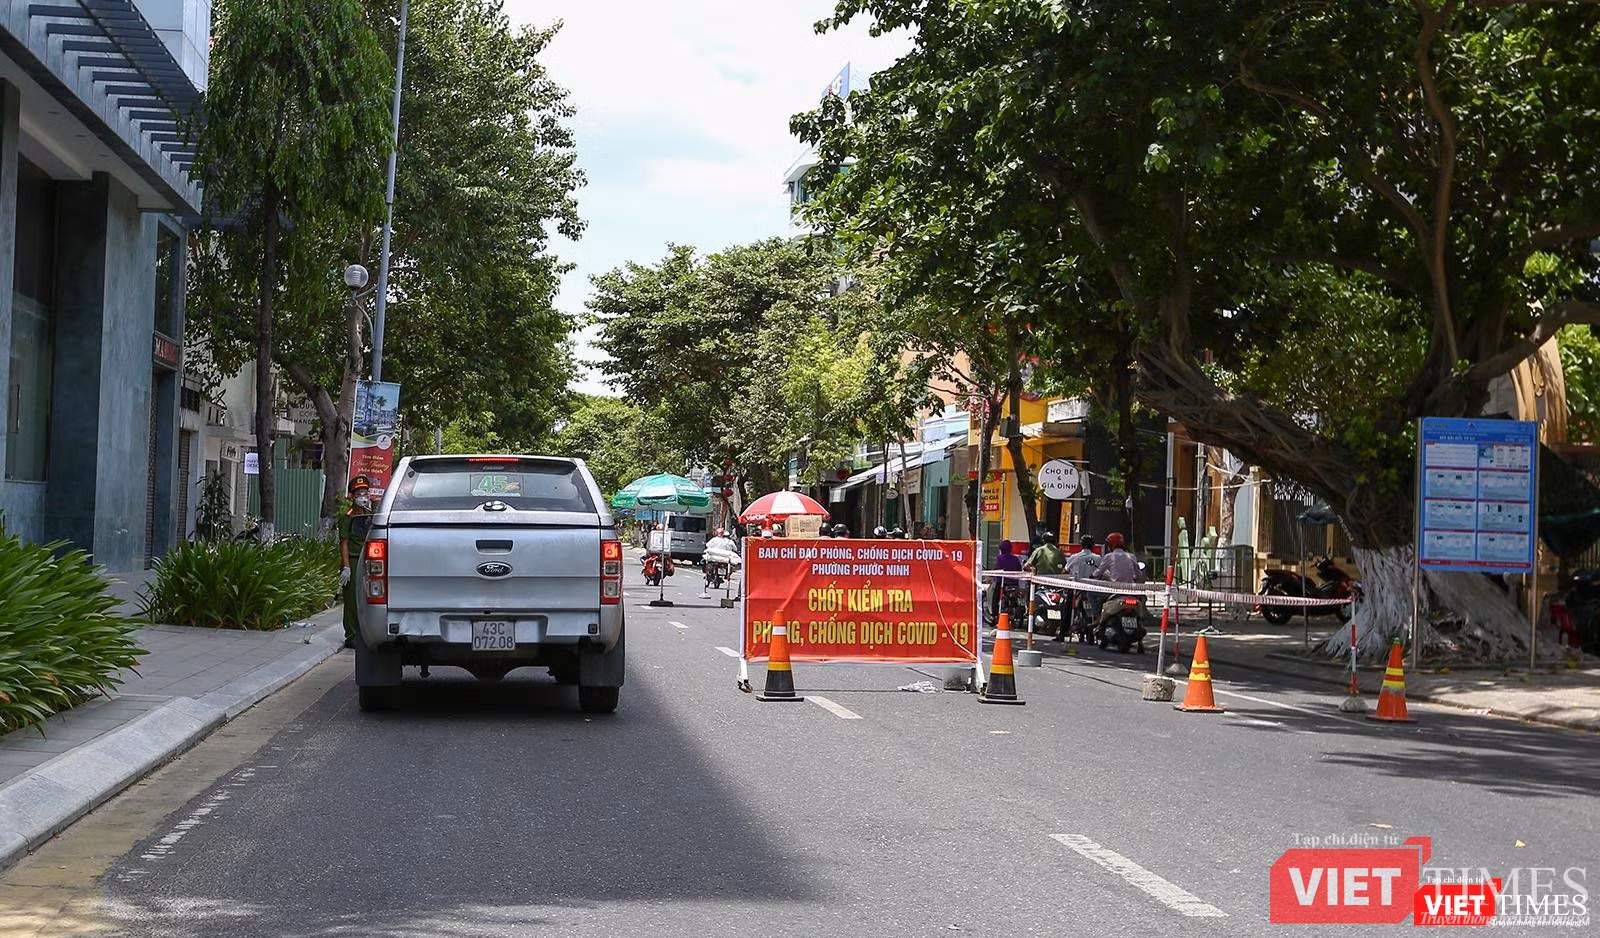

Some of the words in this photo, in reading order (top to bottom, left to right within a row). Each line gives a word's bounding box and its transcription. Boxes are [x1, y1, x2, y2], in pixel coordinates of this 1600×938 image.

[758, 547, 779, 559] BAN
[780, 544, 797, 559] CHỈ
[799, 547, 818, 561] ĐẠO
[820, 545, 855, 560] PHÒNG,
[857, 545, 889, 560] CHỐNG
[891, 549, 913, 562] DỊCH
[916, 549, 943, 560] COVID
[951, 550, 963, 561] 19
[484, 564, 504, 573] Ford
[812, 561, 850, 575] PHƯỜNG
[852, 562, 884, 576] PHƯỚC
[886, 565, 910, 576] NINH
[808, 580, 844, 612] CHỐT
[847, 580, 883, 612] KIỂM
[887, 589, 913, 612] TRA
[482, 622, 505, 636] 43C
[752, 620, 804, 646] PHG,
[808, 613, 856, 644] CHỐNG
[860, 621, 893, 649] DỊCH
[897, 621, 938, 645] COVID
[952, 622, 969, 645] 19
